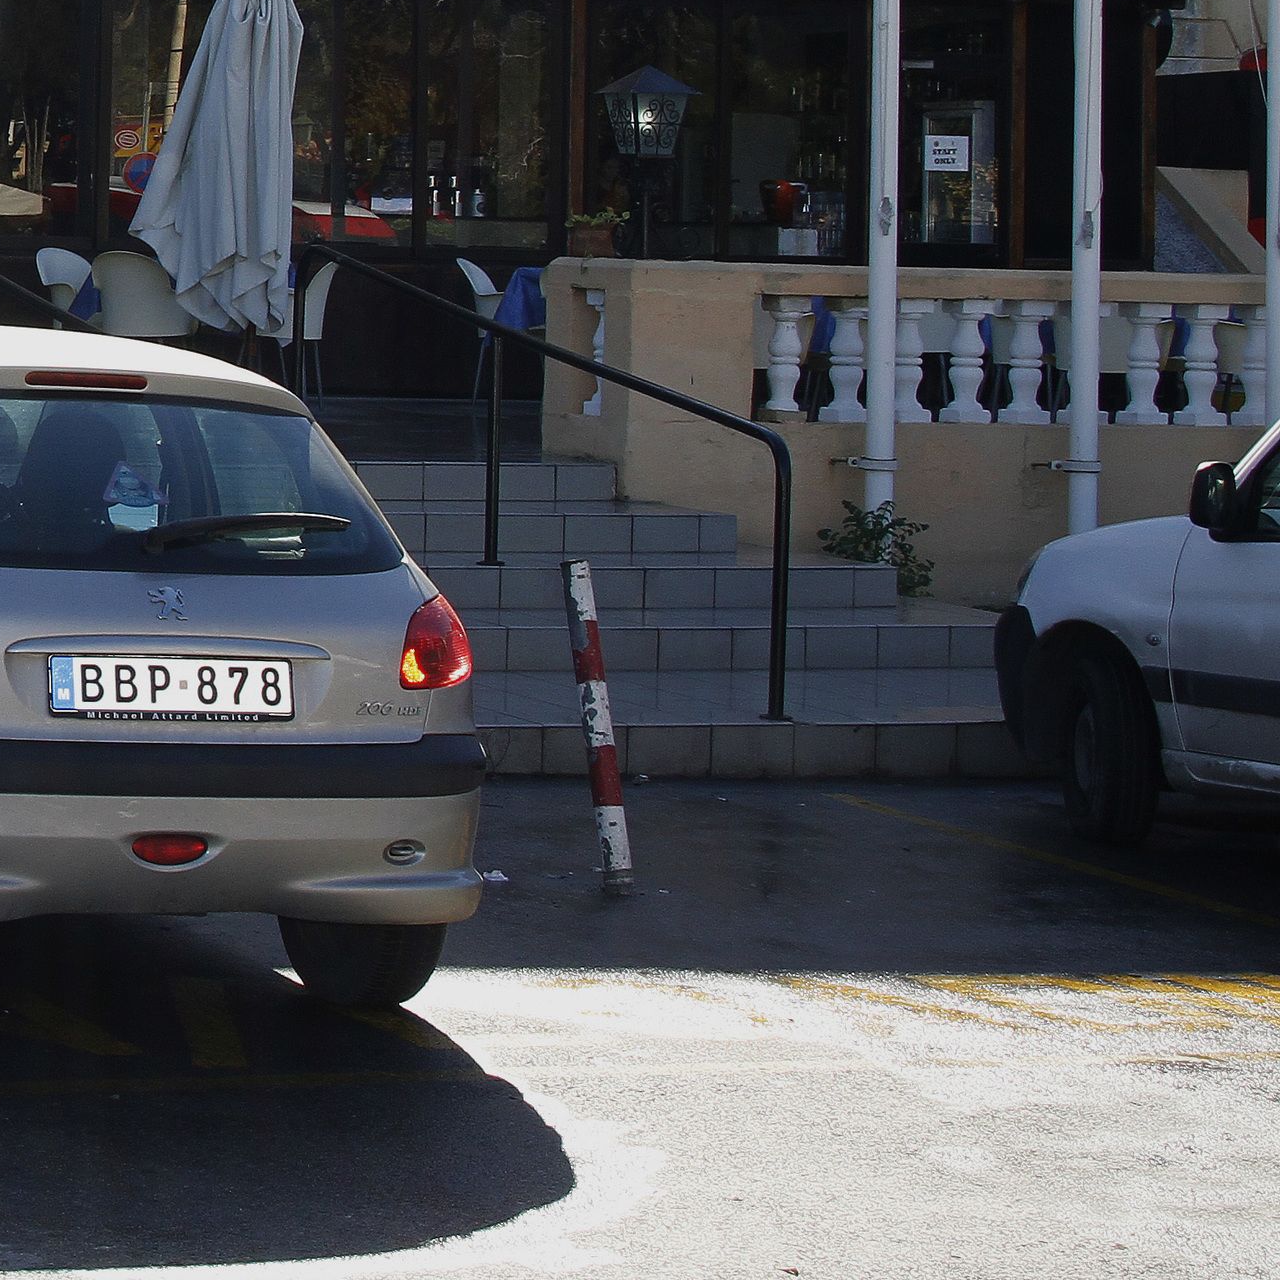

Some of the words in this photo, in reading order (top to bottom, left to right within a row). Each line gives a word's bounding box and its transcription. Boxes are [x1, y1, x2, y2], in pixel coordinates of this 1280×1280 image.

[80, 664, 172, 704] BBP
[197, 666, 283, 706] 878
[57, 688, 70, 700] M
[356, 700, 394, 717] 206
[86, 711, 144, 721] Michael
[151, 711, 198, 721] Attard
[206, 713, 260, 722] Limited
